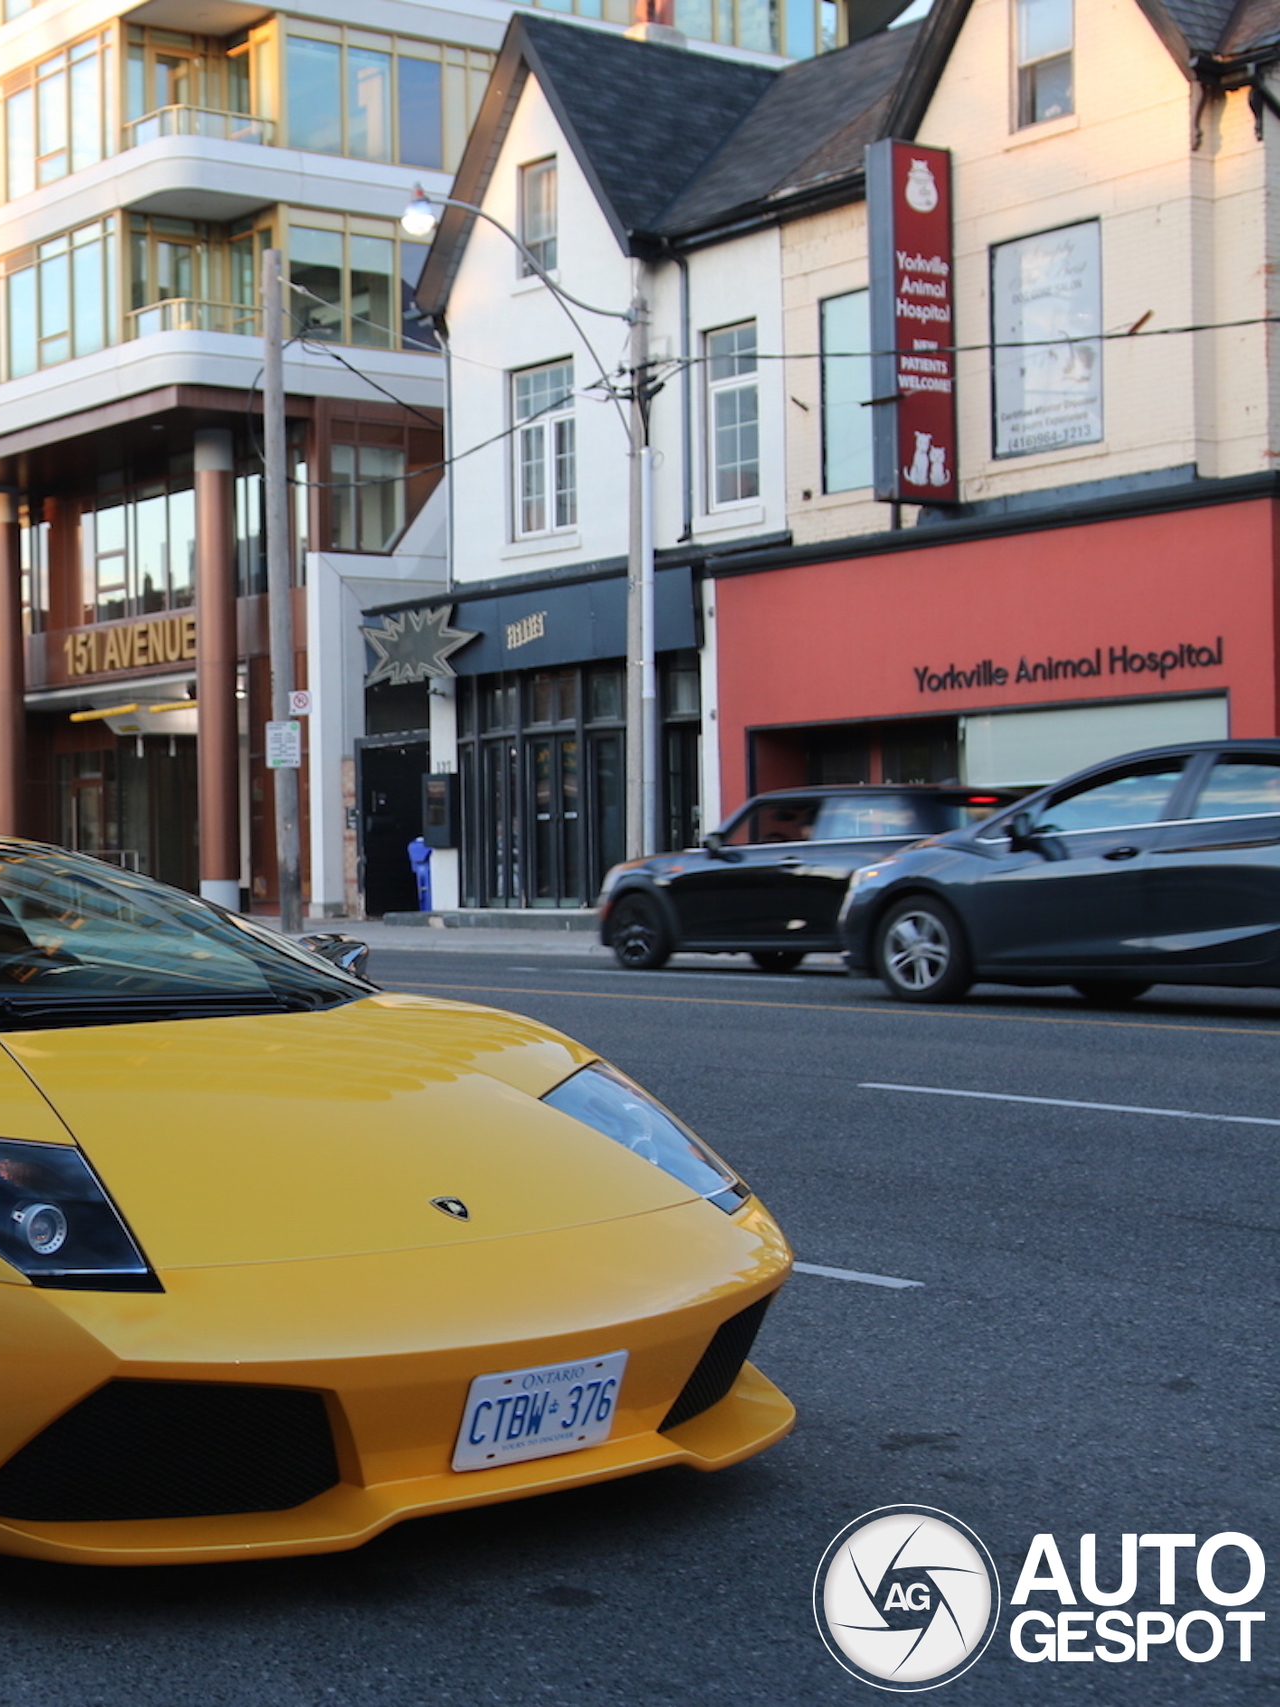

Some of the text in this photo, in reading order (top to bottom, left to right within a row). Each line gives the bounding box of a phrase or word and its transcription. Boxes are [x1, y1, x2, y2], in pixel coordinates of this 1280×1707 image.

[896, 250, 950, 276] Yorkville
[901, 275, 947, 298] Animal
[896, 297, 951, 324] Hospital
[913, 339, 938, 353] NEW
[901, 356, 948, 374] PATIENTS
[63, 613, 197, 675] 151 AVENUE
[913, 636, 1223, 692] Yorkville Animal Hospital
[522, 1367, 585, 1390] ONTARIO
[469, 1377, 616, 1445] CTBW 376
